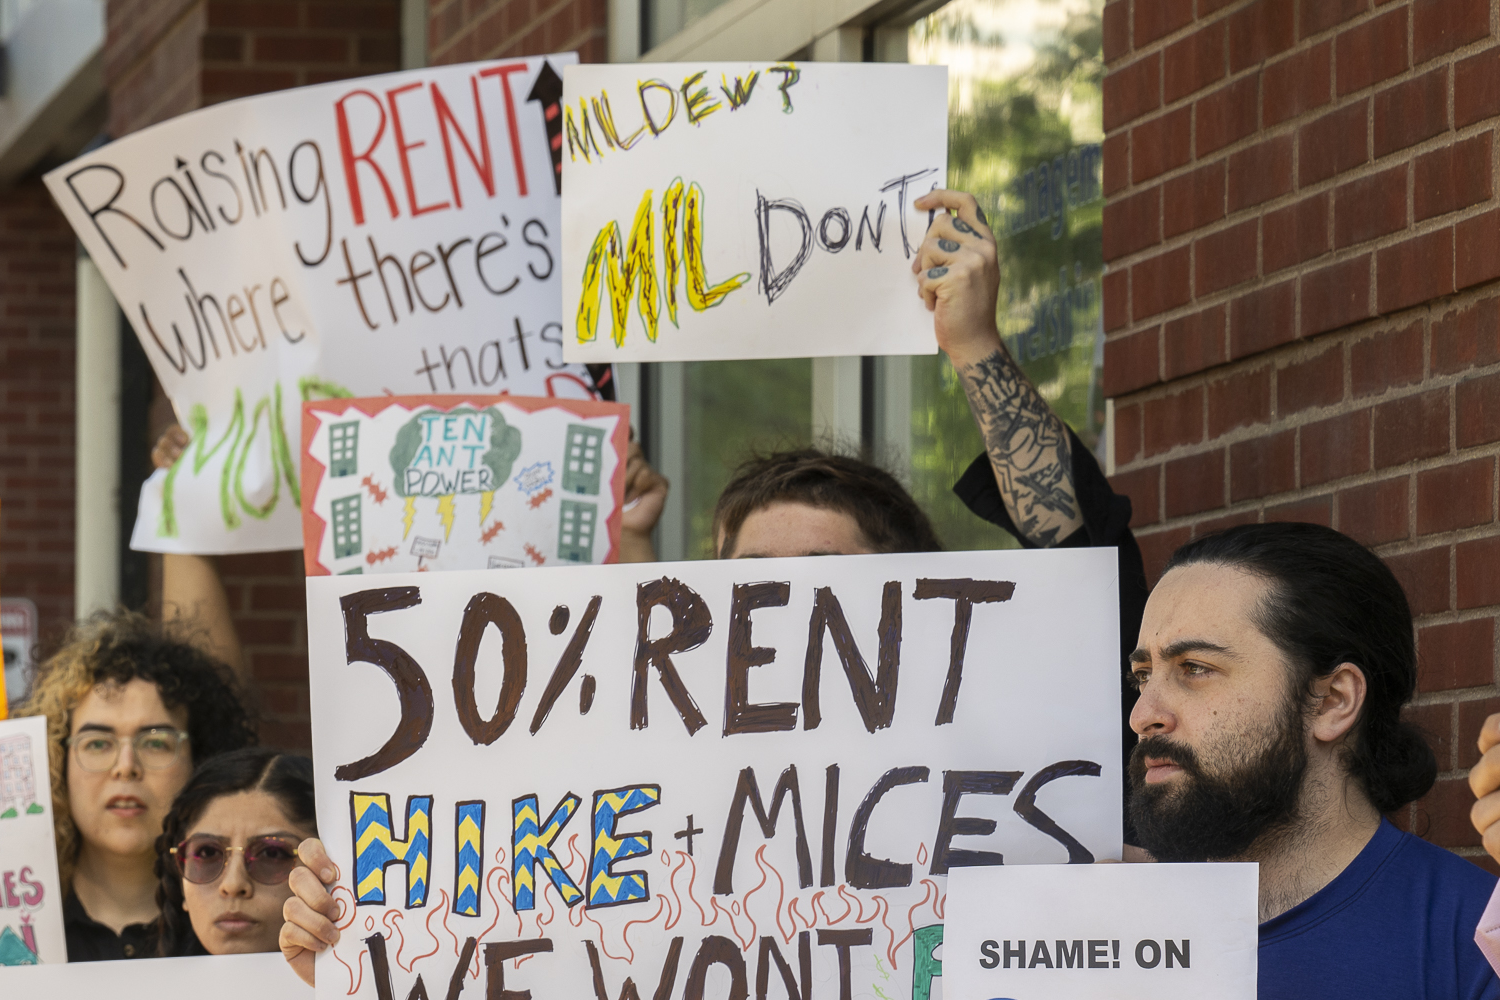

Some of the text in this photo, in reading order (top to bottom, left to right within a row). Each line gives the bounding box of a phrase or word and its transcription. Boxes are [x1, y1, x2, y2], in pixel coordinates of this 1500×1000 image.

[63, 62, 530, 271] Raising RENT
[336, 213, 556, 331] there's
[576, 175, 752, 349] MIL
[405, 468, 496, 497] POWER
[413, 444, 485, 469] ANT
[419, 415, 486, 442] TEN
[334, 575, 1018, 783] 50% RENT
[348, 783, 663, 918] HIKE
[711, 760, 1103, 898] MICES
[978, 938, 1191, 970] SHAME! ON
